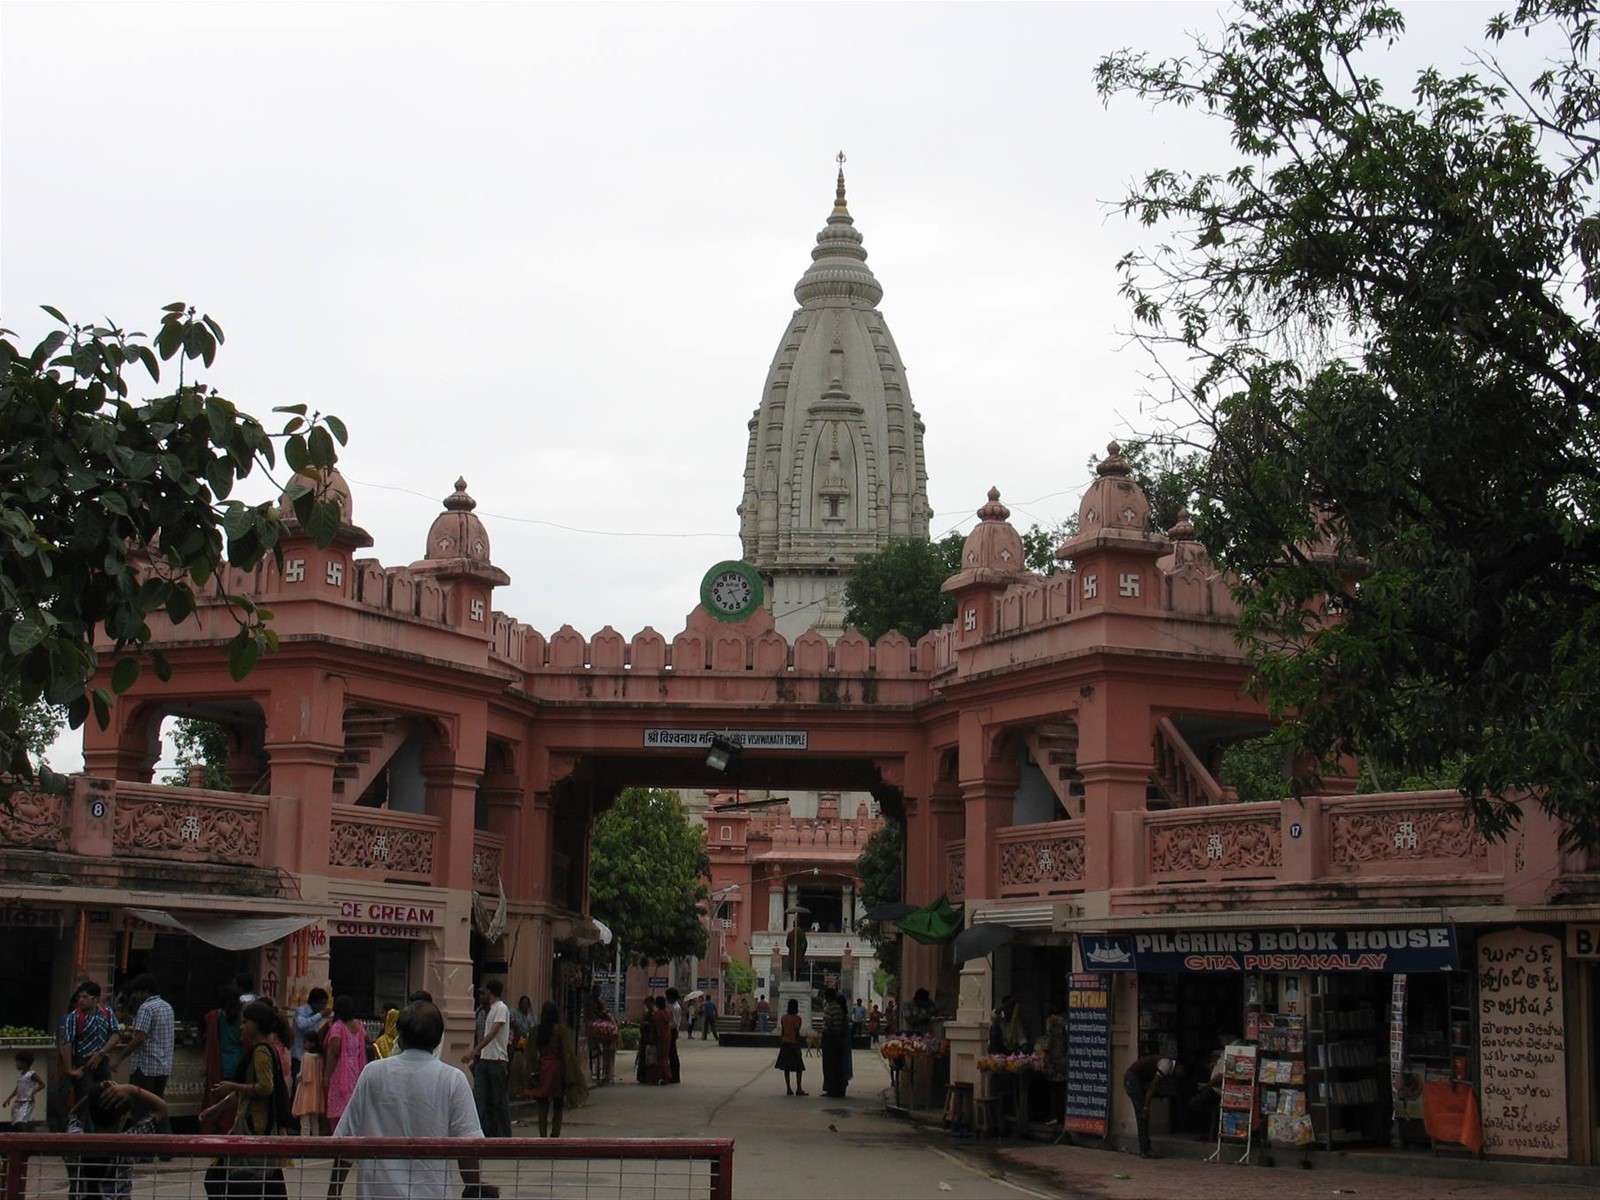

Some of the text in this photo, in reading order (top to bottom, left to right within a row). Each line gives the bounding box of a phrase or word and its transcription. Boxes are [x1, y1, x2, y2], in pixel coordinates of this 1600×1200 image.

[647, 731, 658, 744] श्री
[660, 731, 697, 744] विश्वनाथ
[748, 734, 784, 746] VISHWANATH
[785, 735, 805, 746] TEMPLE
[94, 803, 103, 817] 8
[1291, 825, 1300, 837] 17
[368, 904, 434, 923] CREAM
[337, 923, 421, 938] COLD COFFEE
[1135, 928, 1450, 953] PILGRIMS BOOK HOUSE
[1184, 953, 1388, 970] GITA PUSTAKALAY
